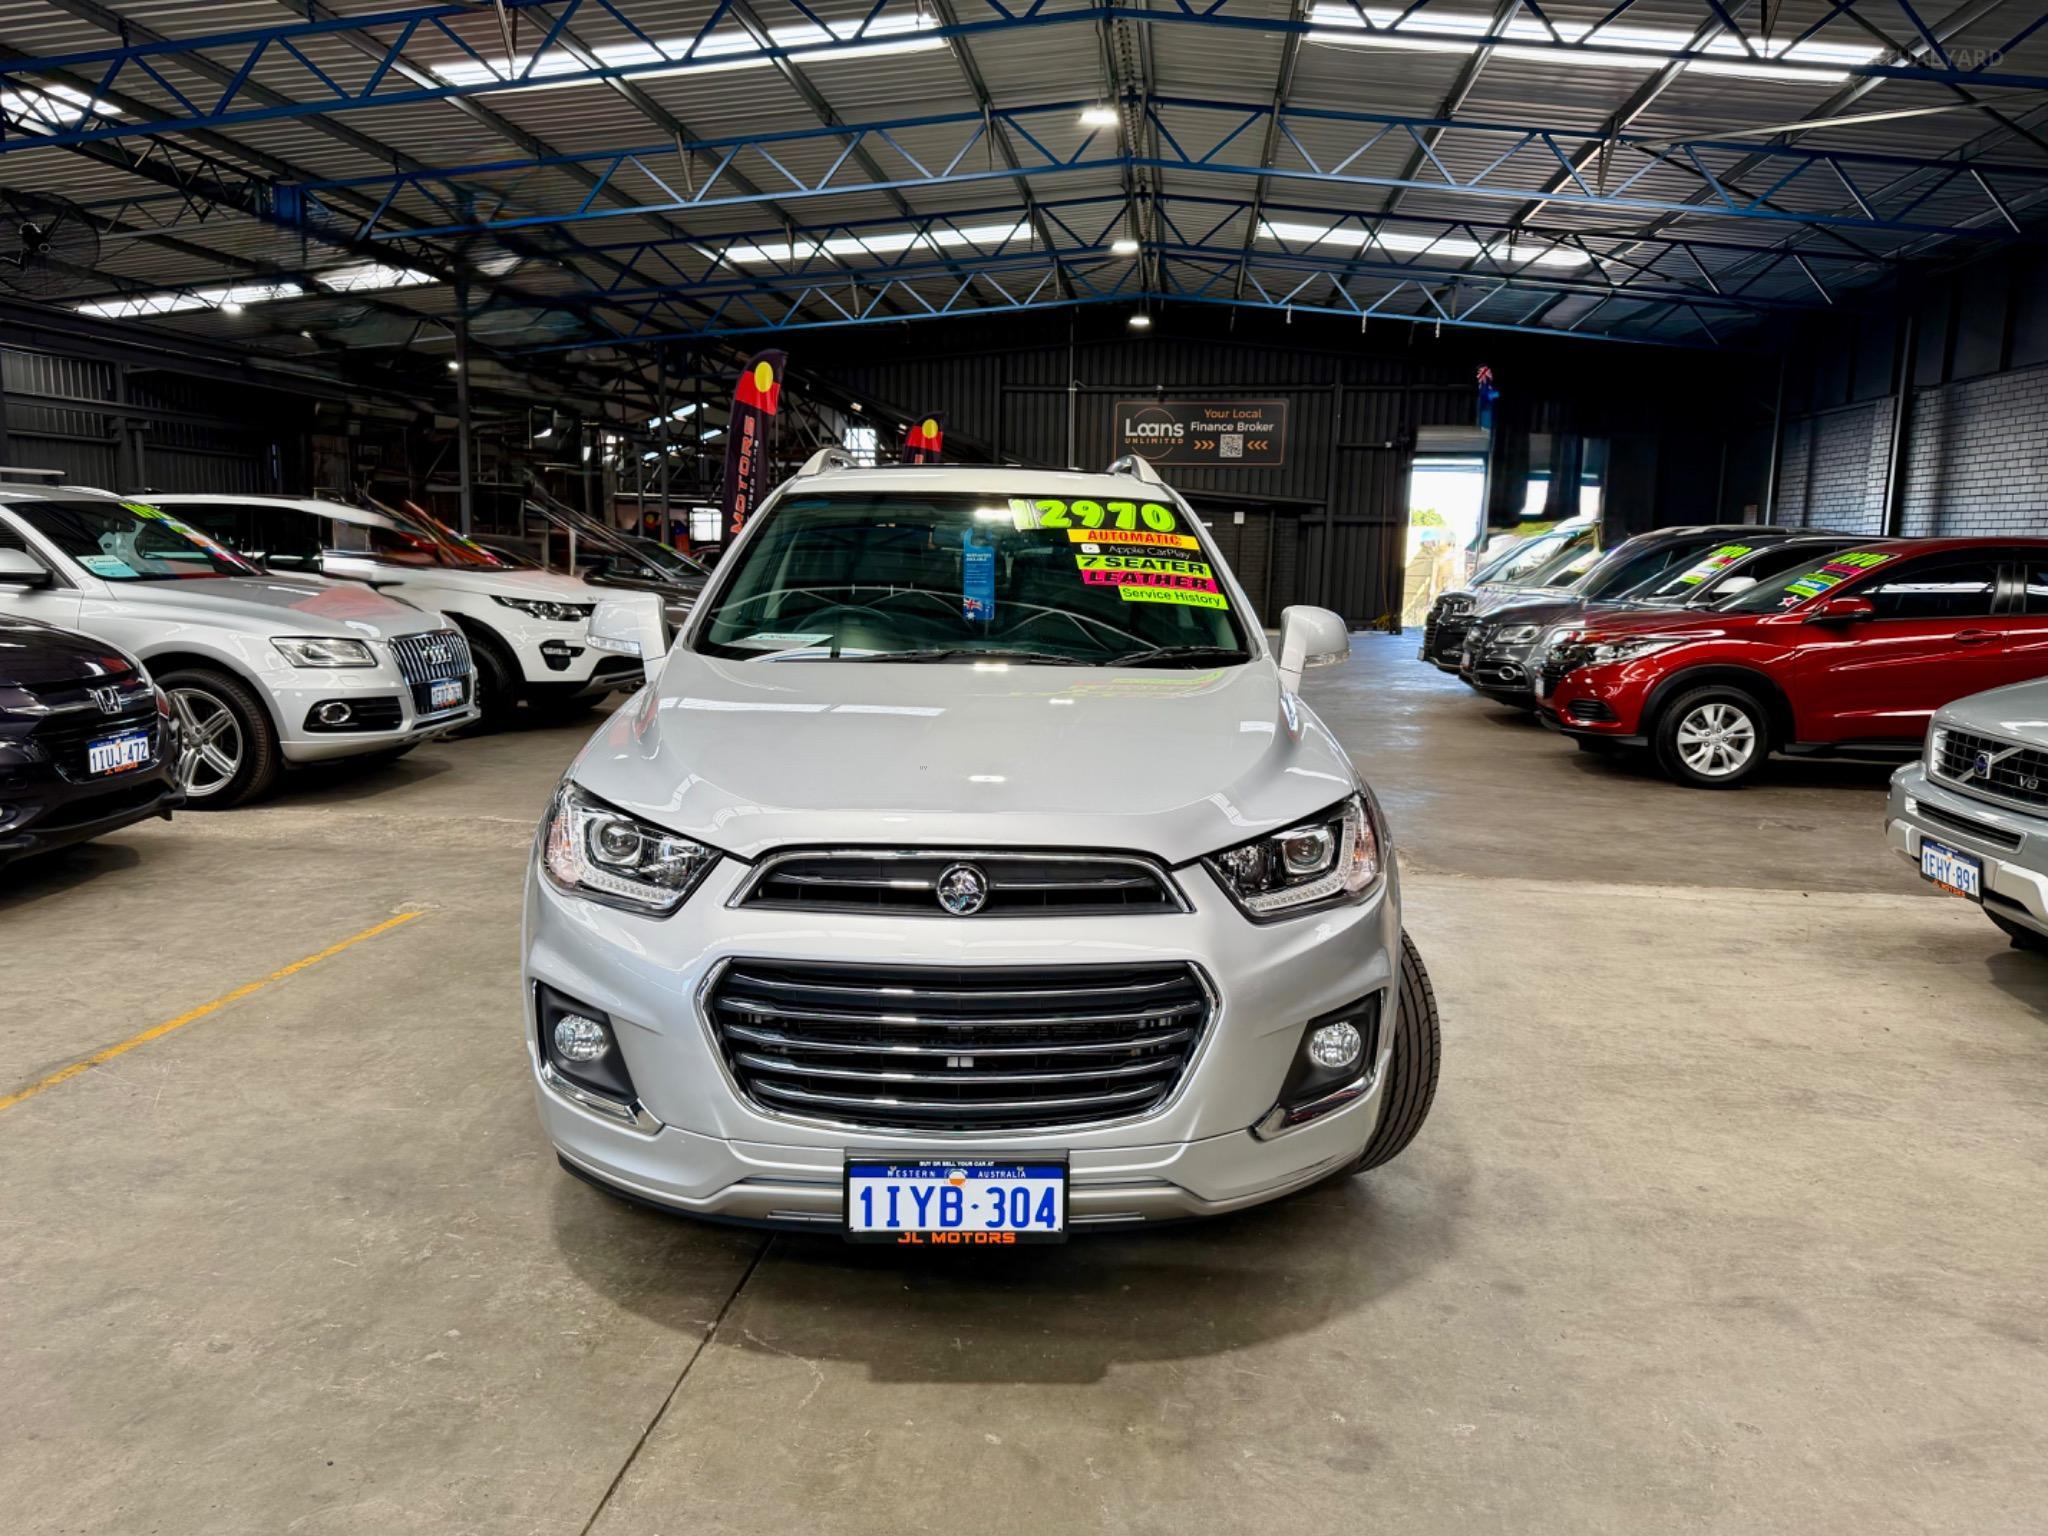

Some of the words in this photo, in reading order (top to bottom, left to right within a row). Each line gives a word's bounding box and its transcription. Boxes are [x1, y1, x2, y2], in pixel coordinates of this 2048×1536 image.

[1204, 408, 1229, 419] Your
[1233, 408, 1262, 419] Local
[1125, 418, 1185, 437] Loans
[1190, 421, 1234, 432] Finance
[1237, 421, 1274, 432] Broker
[730, 415, 756, 535] MOTORS
[1088, 529, 1182, 546] AUTOMATIC
[1108, 545, 1145, 555] Apple
[1147, 547, 1191, 560] CarPlay
[1081, 556, 1098, 567] 7
[1104, 556, 1205, 575] SEATER
[1089, 571, 1209, 589] LEATHER
[1122, 588, 1172, 600] Service
[1174, 590, 1221, 606] History
[887, 1170, 936, 1178] WESTERN
[977, 1170, 1026, 1178] AUSTRALIA
[897, 1231, 923, 1244] JL
[931, 1231, 1016, 1244] MOTORS
